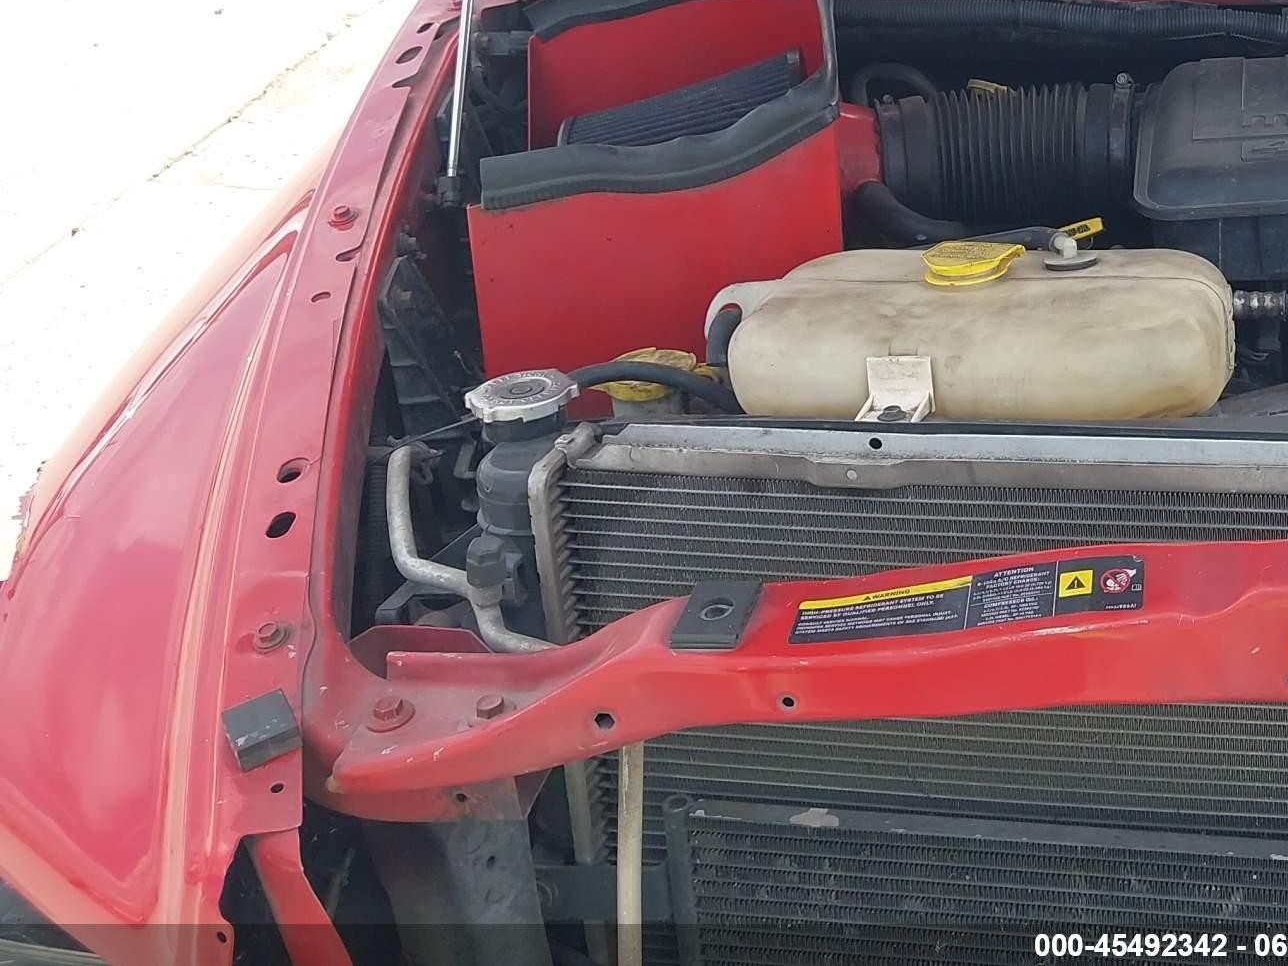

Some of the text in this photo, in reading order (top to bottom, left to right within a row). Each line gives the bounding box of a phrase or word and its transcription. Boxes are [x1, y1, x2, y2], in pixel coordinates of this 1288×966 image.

[993, 567, 1034, 578] ATTENTION
[872, 589, 910, 600] WARNING
[900, 596, 925, 604] SYSTEM
